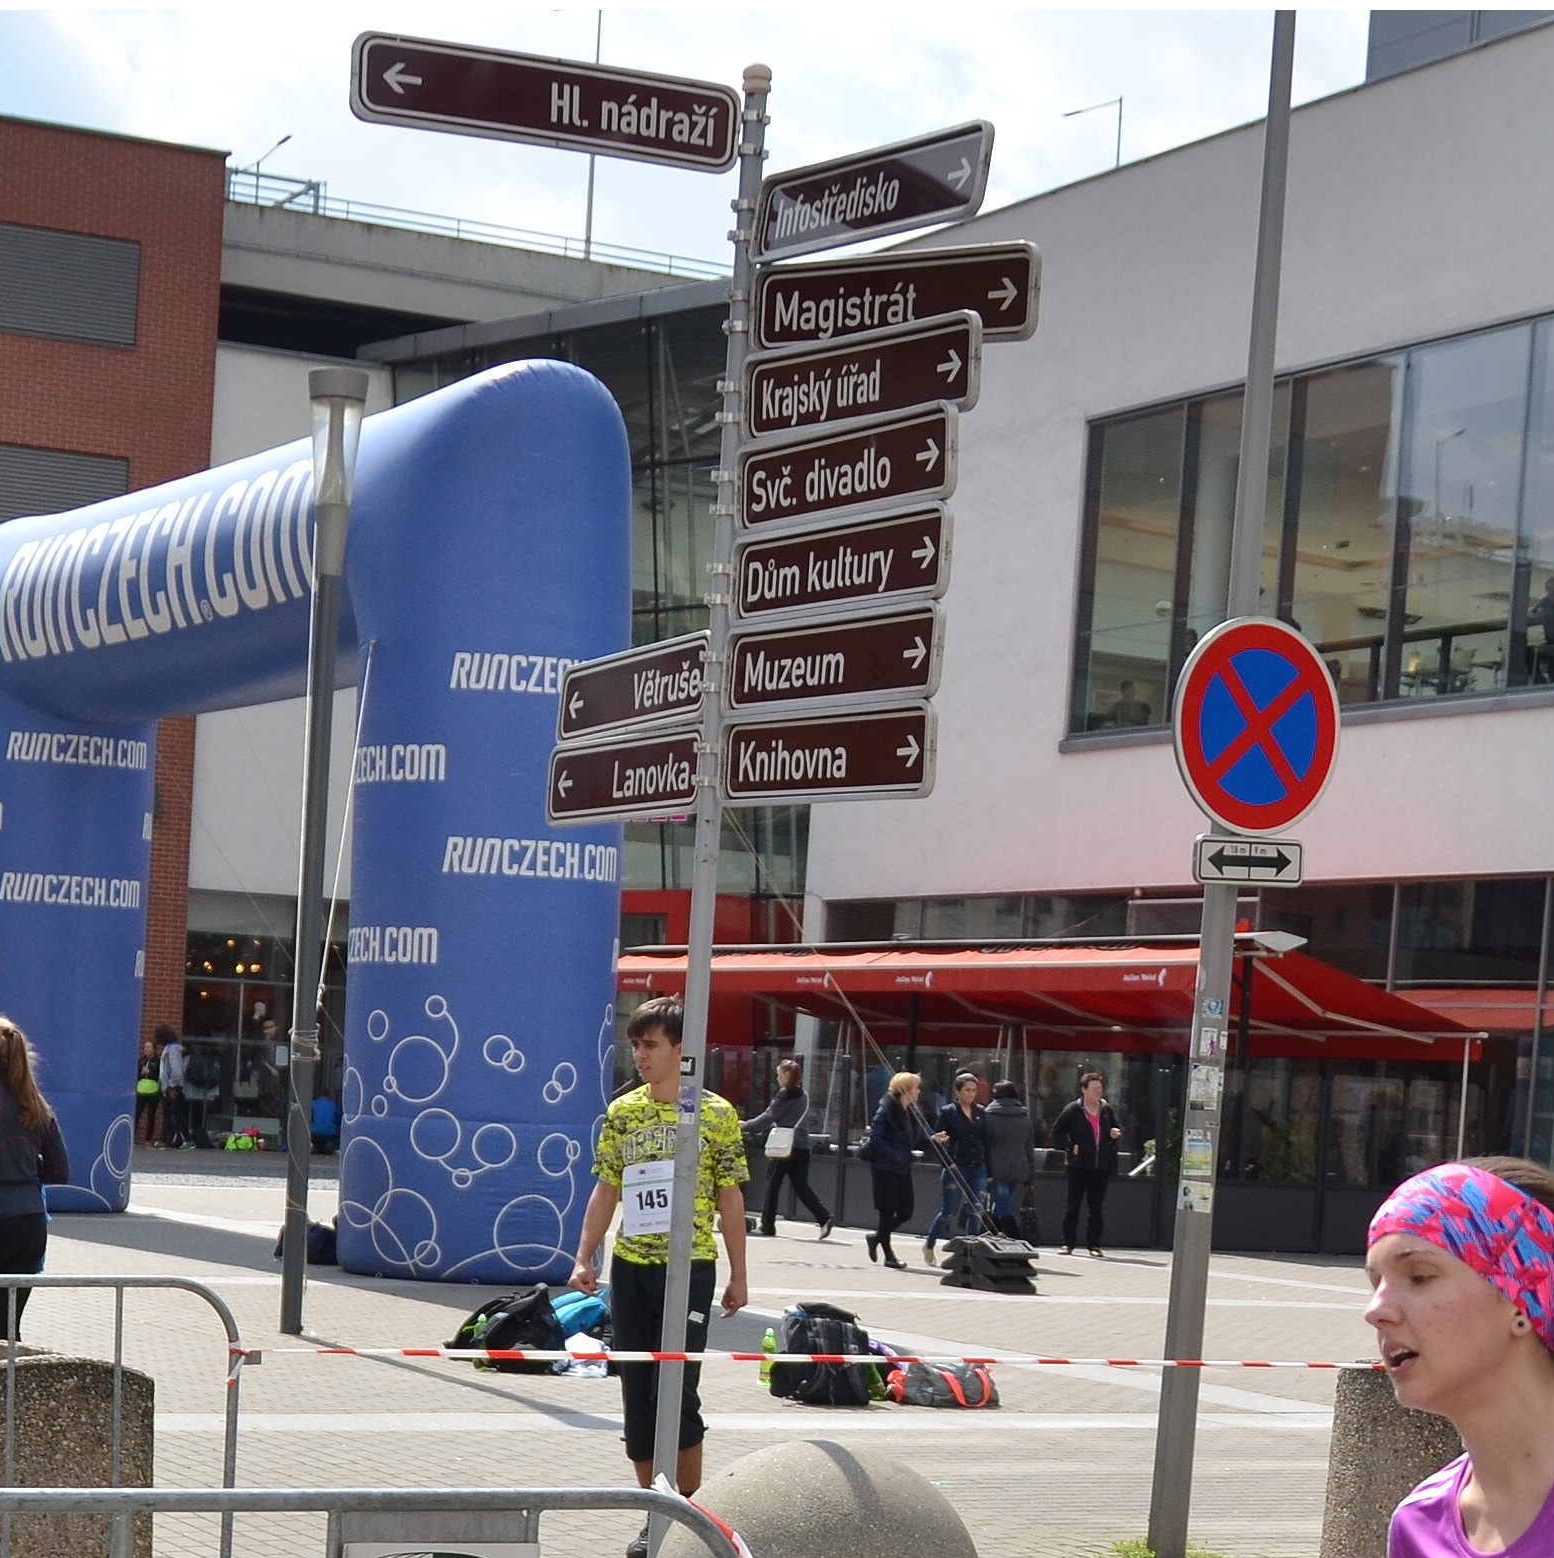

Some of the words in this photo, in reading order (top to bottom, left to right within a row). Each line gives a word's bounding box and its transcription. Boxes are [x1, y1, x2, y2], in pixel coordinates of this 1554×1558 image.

[549, 82, 589, 129] Hl.
[600, 94, 719, 148] nádraží
[774, 171, 901, 241] Infostředisko
[772, 282, 917, 341] Magistrát
[761, 367, 832, 421] Krajský
[836, 358, 881, 407] úřad
[751, 466, 797, 513] Svč.
[805, 447, 891, 503] divadlo
[747, 557, 800, 602] Dům
[807, 547, 894, 593] kultury
[450, 652, 588, 694] RUNCZEC
[633, 660, 700, 711] Větruše
[743, 650, 845, 693] Muzeum
[6, 731, 147, 770] RUNCZECH.COM
[738, 740, 847, 783] Knihovna
[612, 758, 690, 799] Lanovka
[442, 836, 618, 882] RUNCZECH.COM
[0, 872, 140, 908] RUNCZECH.COM
[636, 1188, 668, 1211] 145
